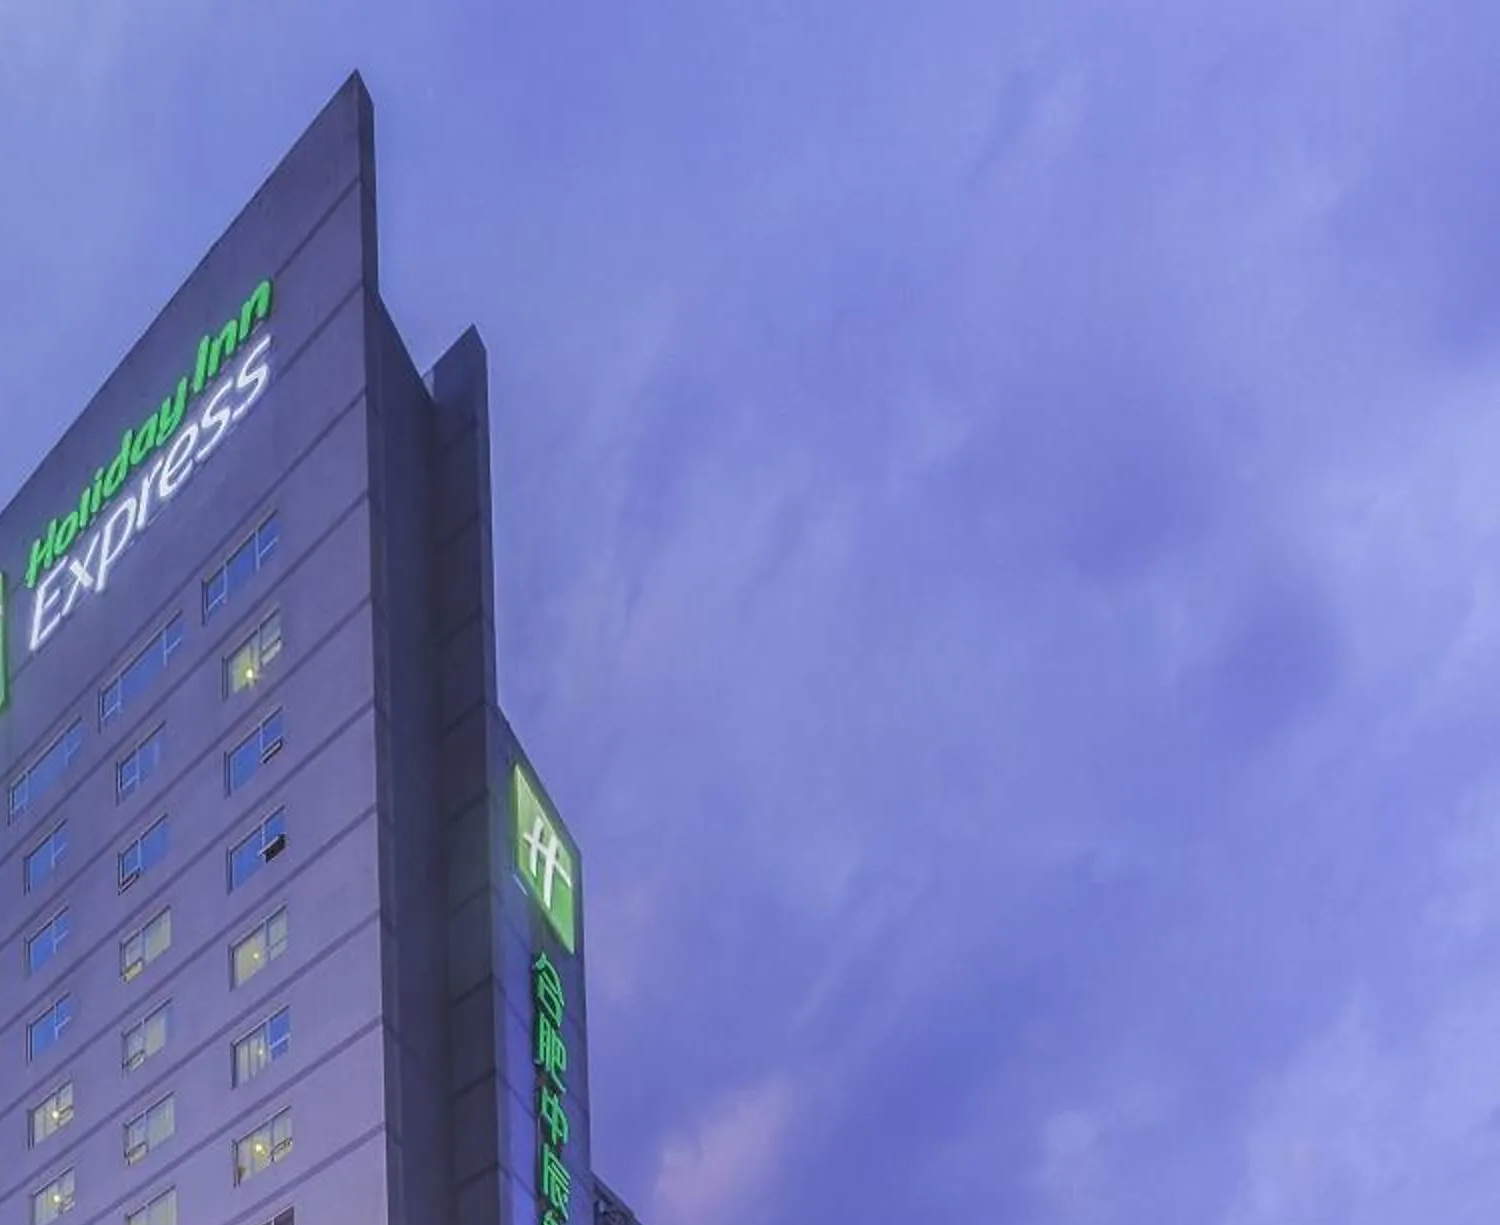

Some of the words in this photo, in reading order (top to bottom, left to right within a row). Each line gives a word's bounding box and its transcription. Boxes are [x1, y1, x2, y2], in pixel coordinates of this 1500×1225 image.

[25, 376, 187, 588] Holiday
[193, 278, 273, 393] Inn
[28, 335, 271, 651] Express
